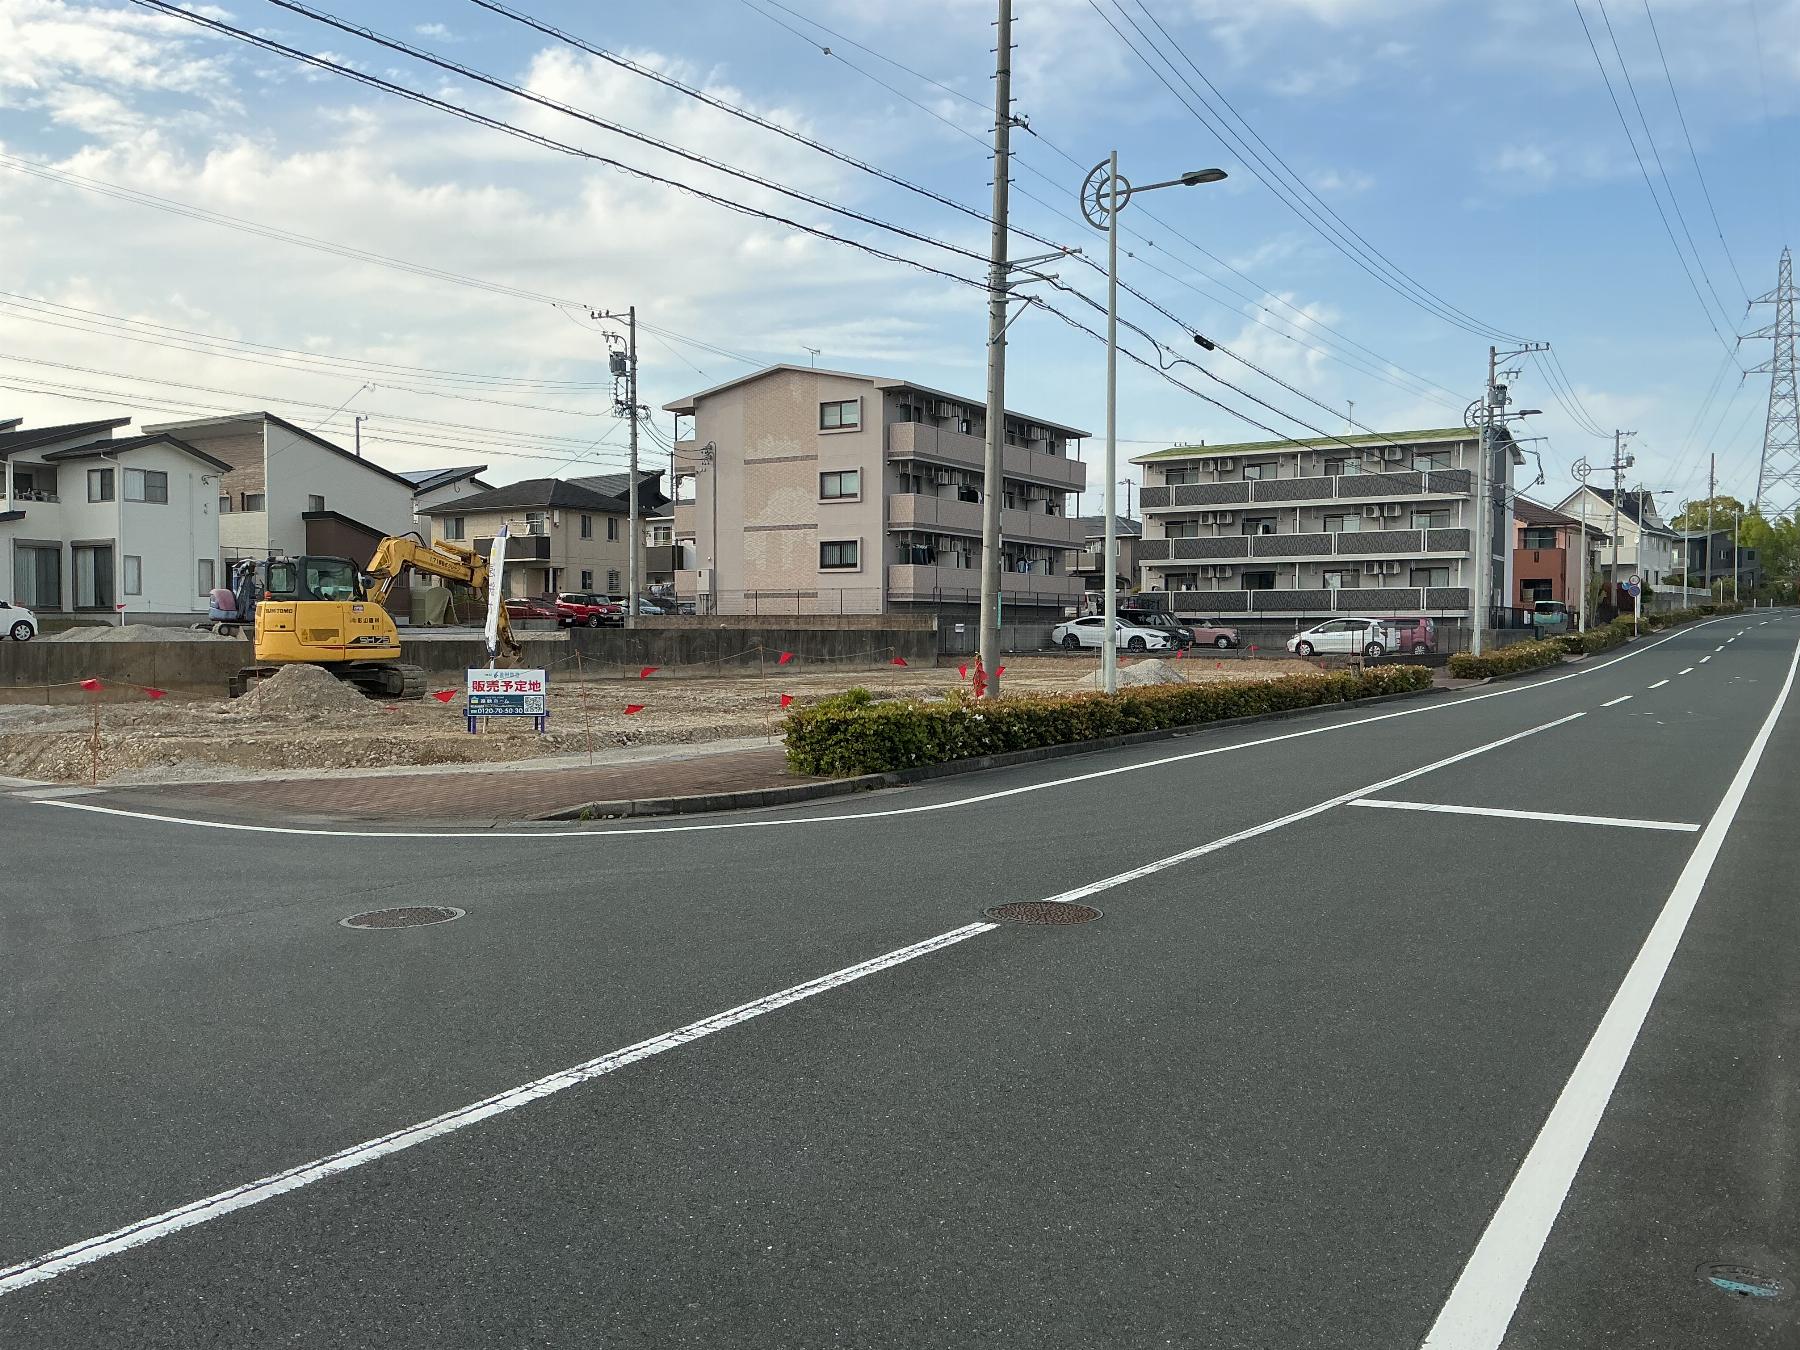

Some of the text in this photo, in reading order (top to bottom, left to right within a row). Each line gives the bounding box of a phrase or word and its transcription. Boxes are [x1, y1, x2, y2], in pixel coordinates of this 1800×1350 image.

[472, 680, 541, 692] 販売予定地
